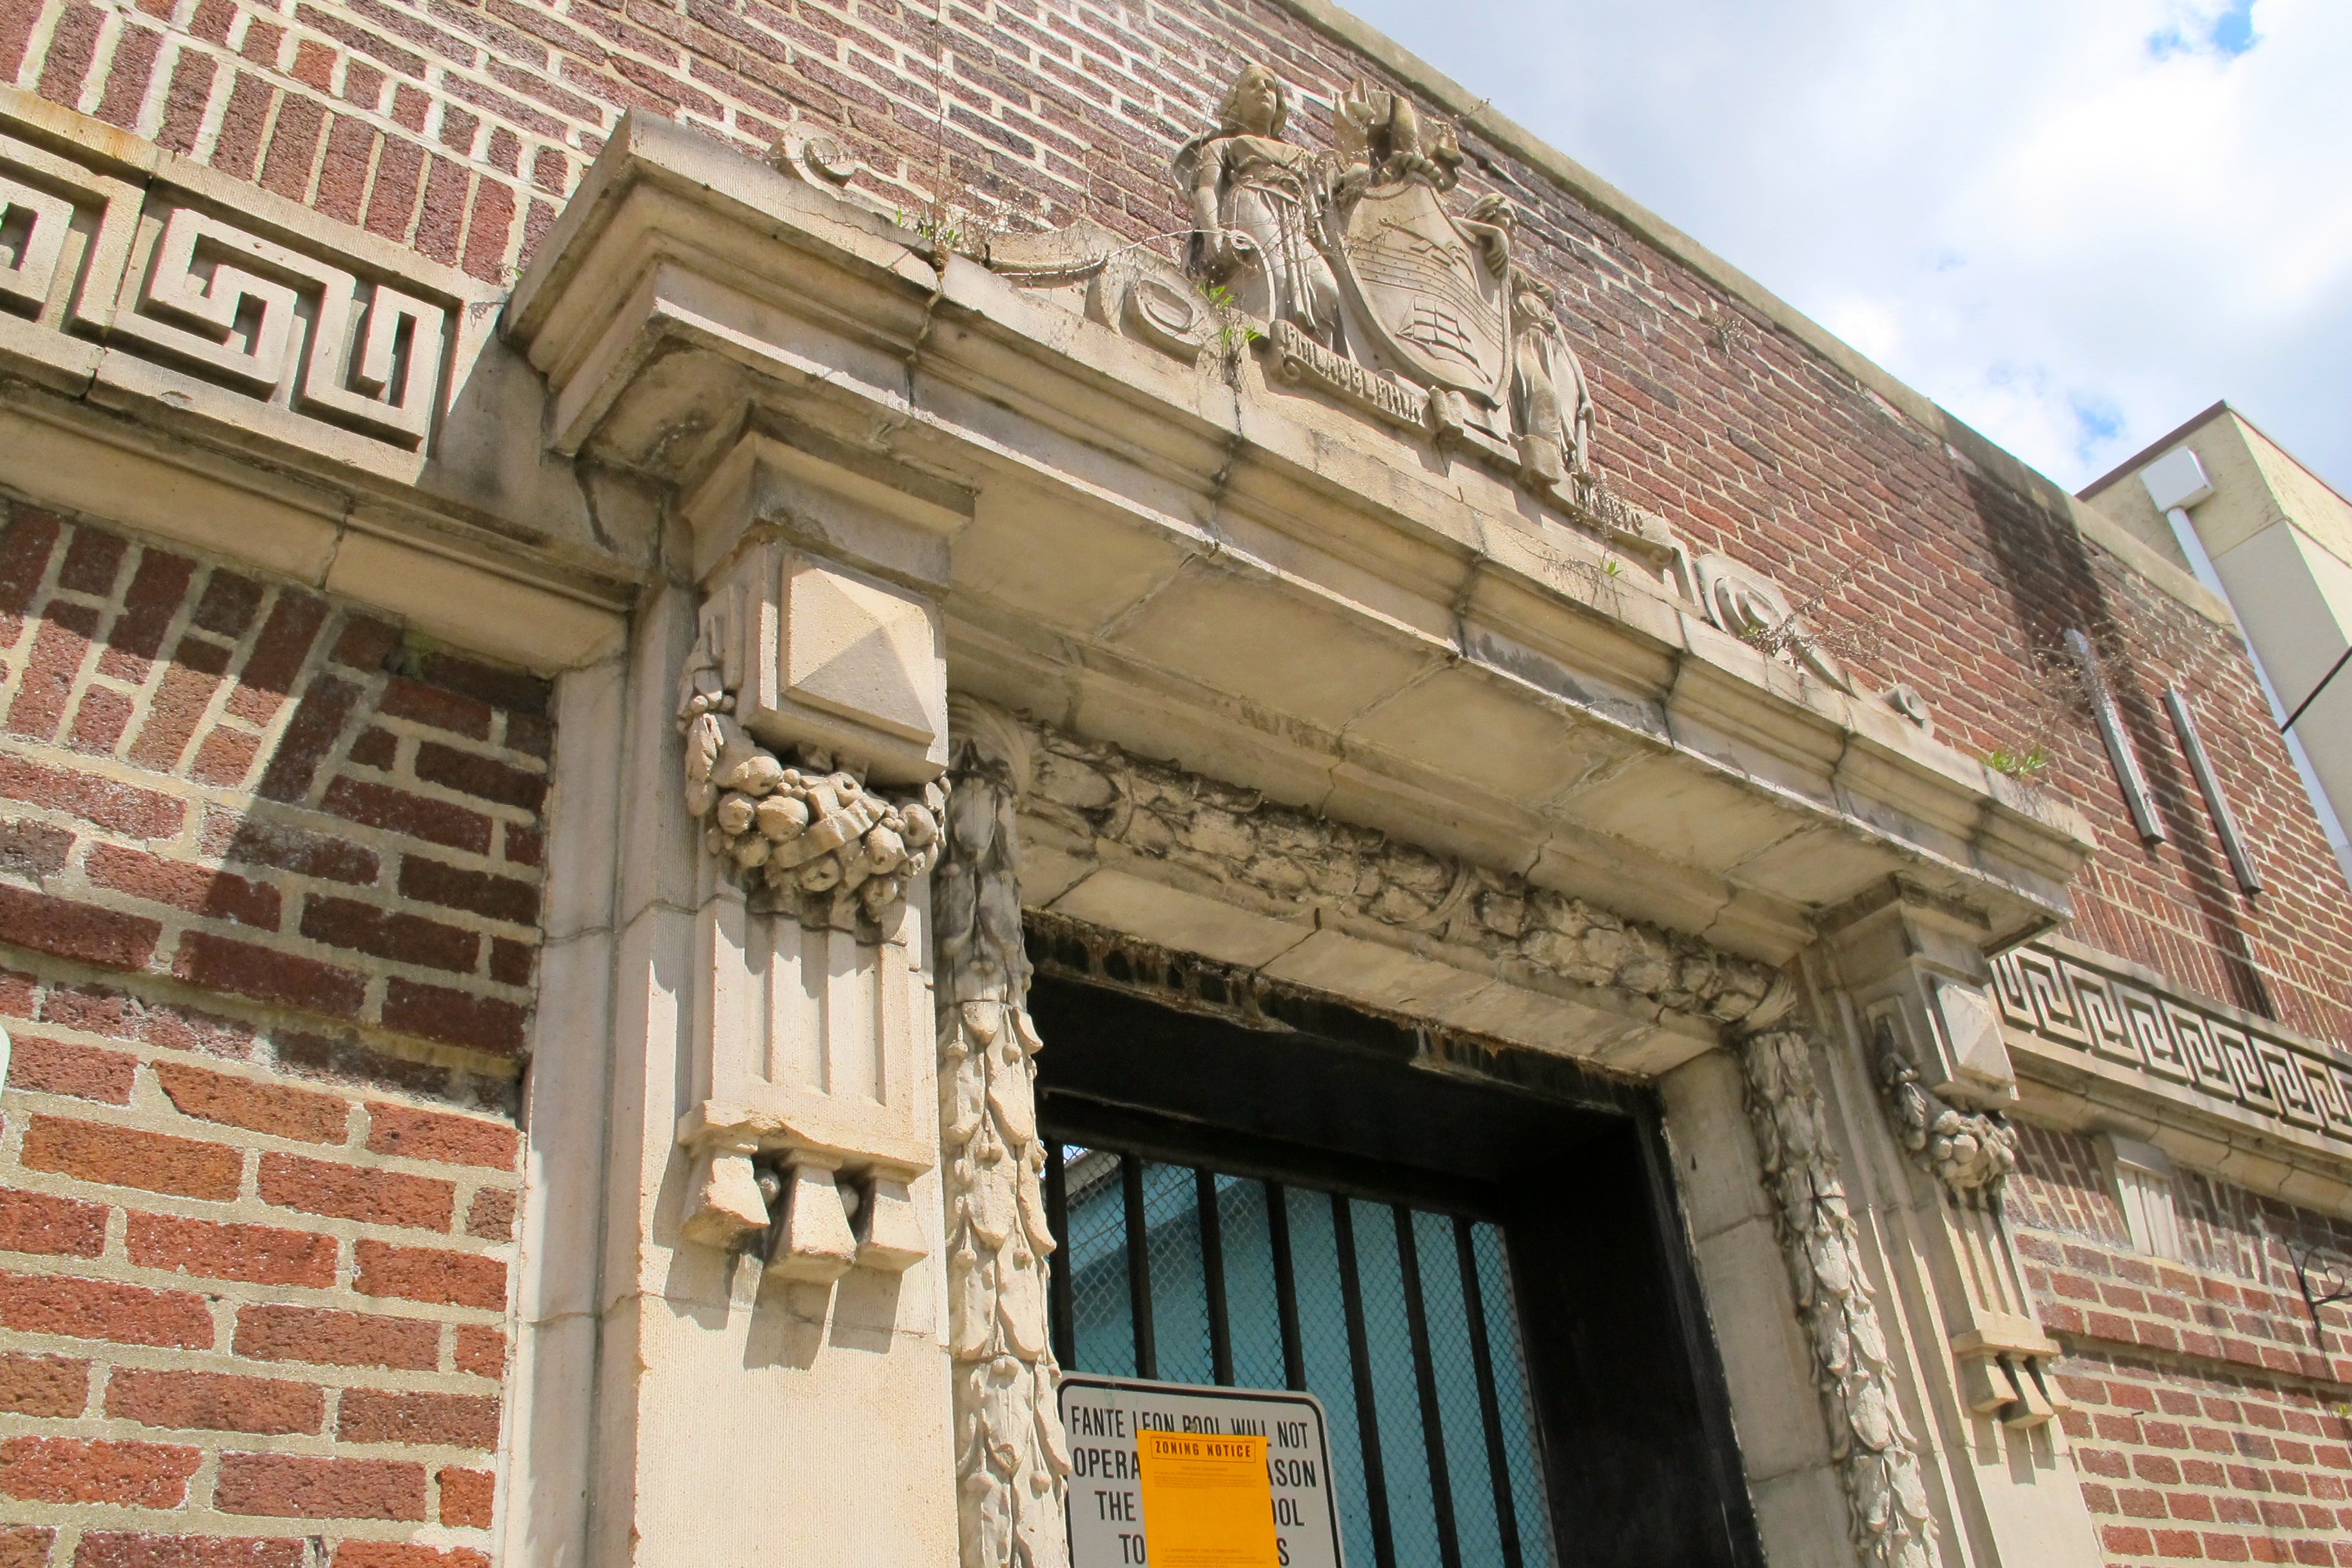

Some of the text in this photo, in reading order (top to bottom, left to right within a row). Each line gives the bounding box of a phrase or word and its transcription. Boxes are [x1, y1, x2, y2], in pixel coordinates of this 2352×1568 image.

[1071, 1405, 1126, 1438] FANTE
[1132, 1410, 1175, 1438] LEON
[1277, 1420, 1308, 1449] NOT
[1073, 1447, 1141, 1480] OPERA
[1155, 1440, 1250, 1458] ZONING NOTICE
[1094, 1490, 1136, 1521] THE
[1119, 1533, 1146, 1565] TO
